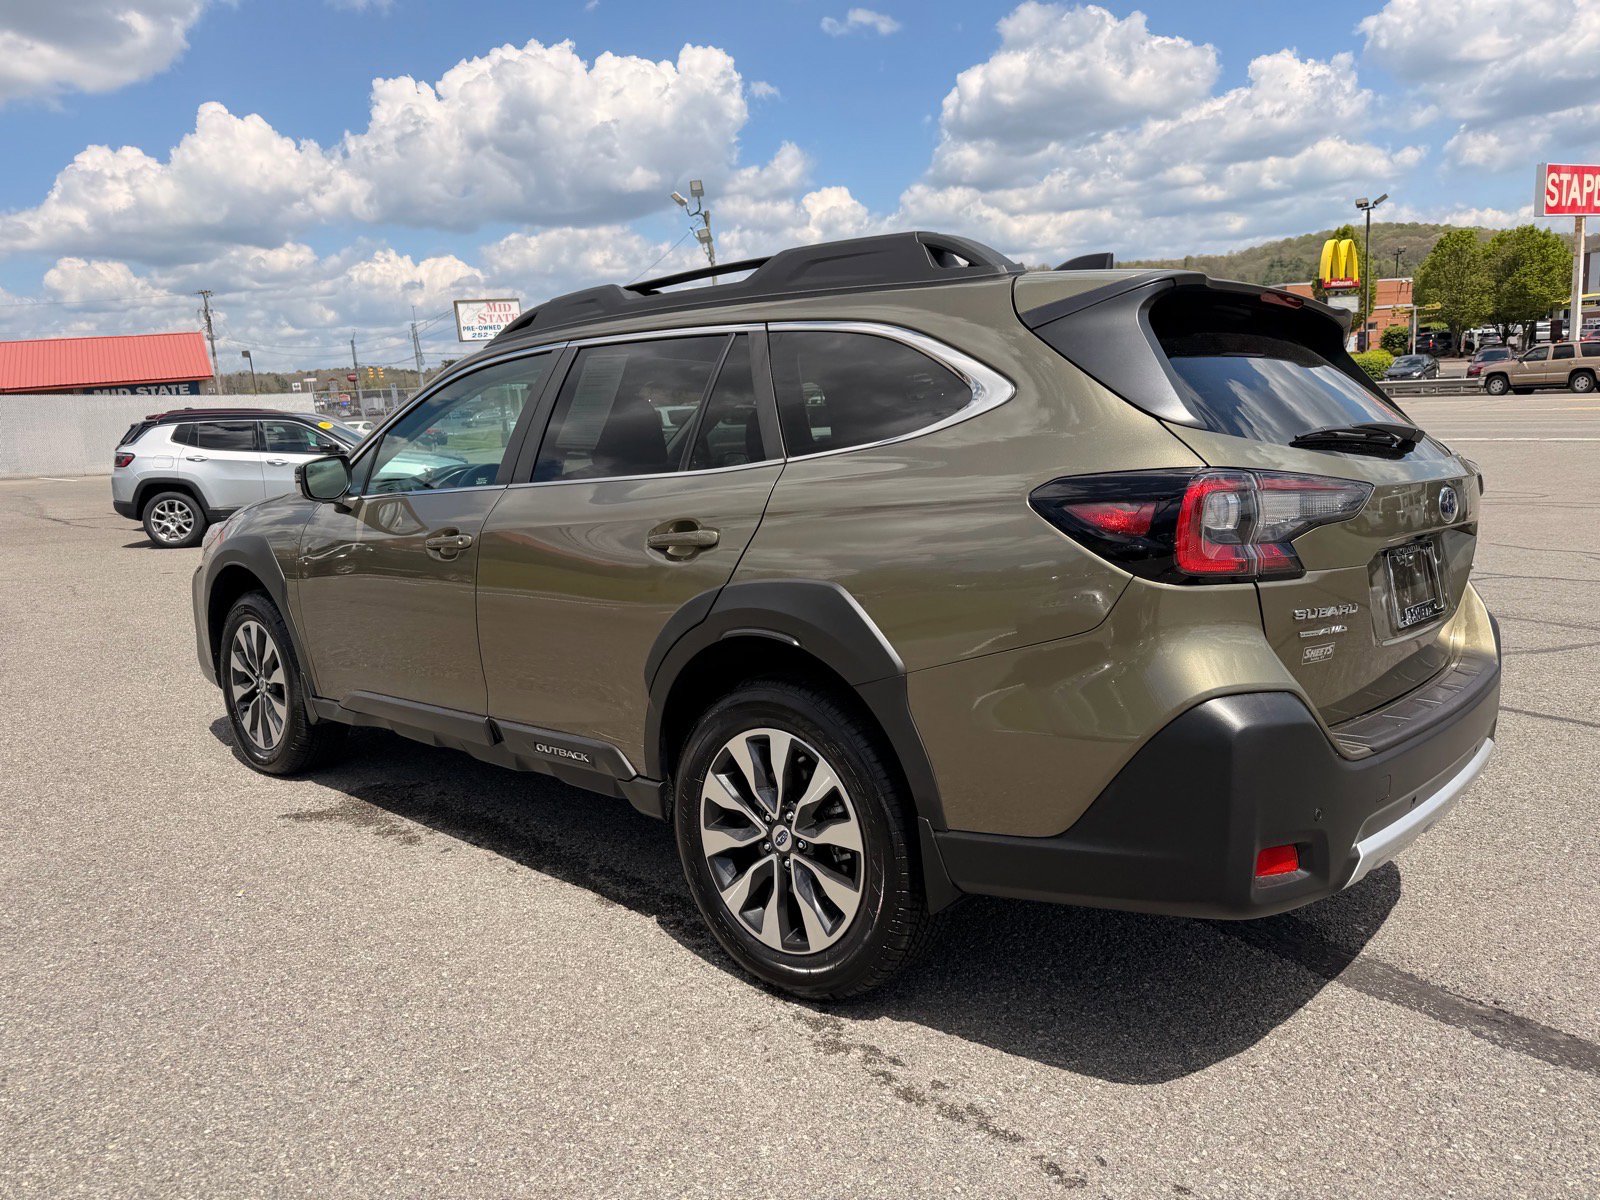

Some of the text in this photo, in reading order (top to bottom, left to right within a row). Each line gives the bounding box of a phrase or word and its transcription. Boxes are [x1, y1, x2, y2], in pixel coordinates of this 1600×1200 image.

[486, 302, 512, 313] MID
[477, 313, 519, 325] STATE
[462, 324, 502, 332] PRE-OWNED
[135, 384, 191, 396] STATE
[1293, 603, 1359, 620] SUBARU
[1303, 644, 1335, 660] SHEETS
[536, 743, 590, 763] OUTBACK
